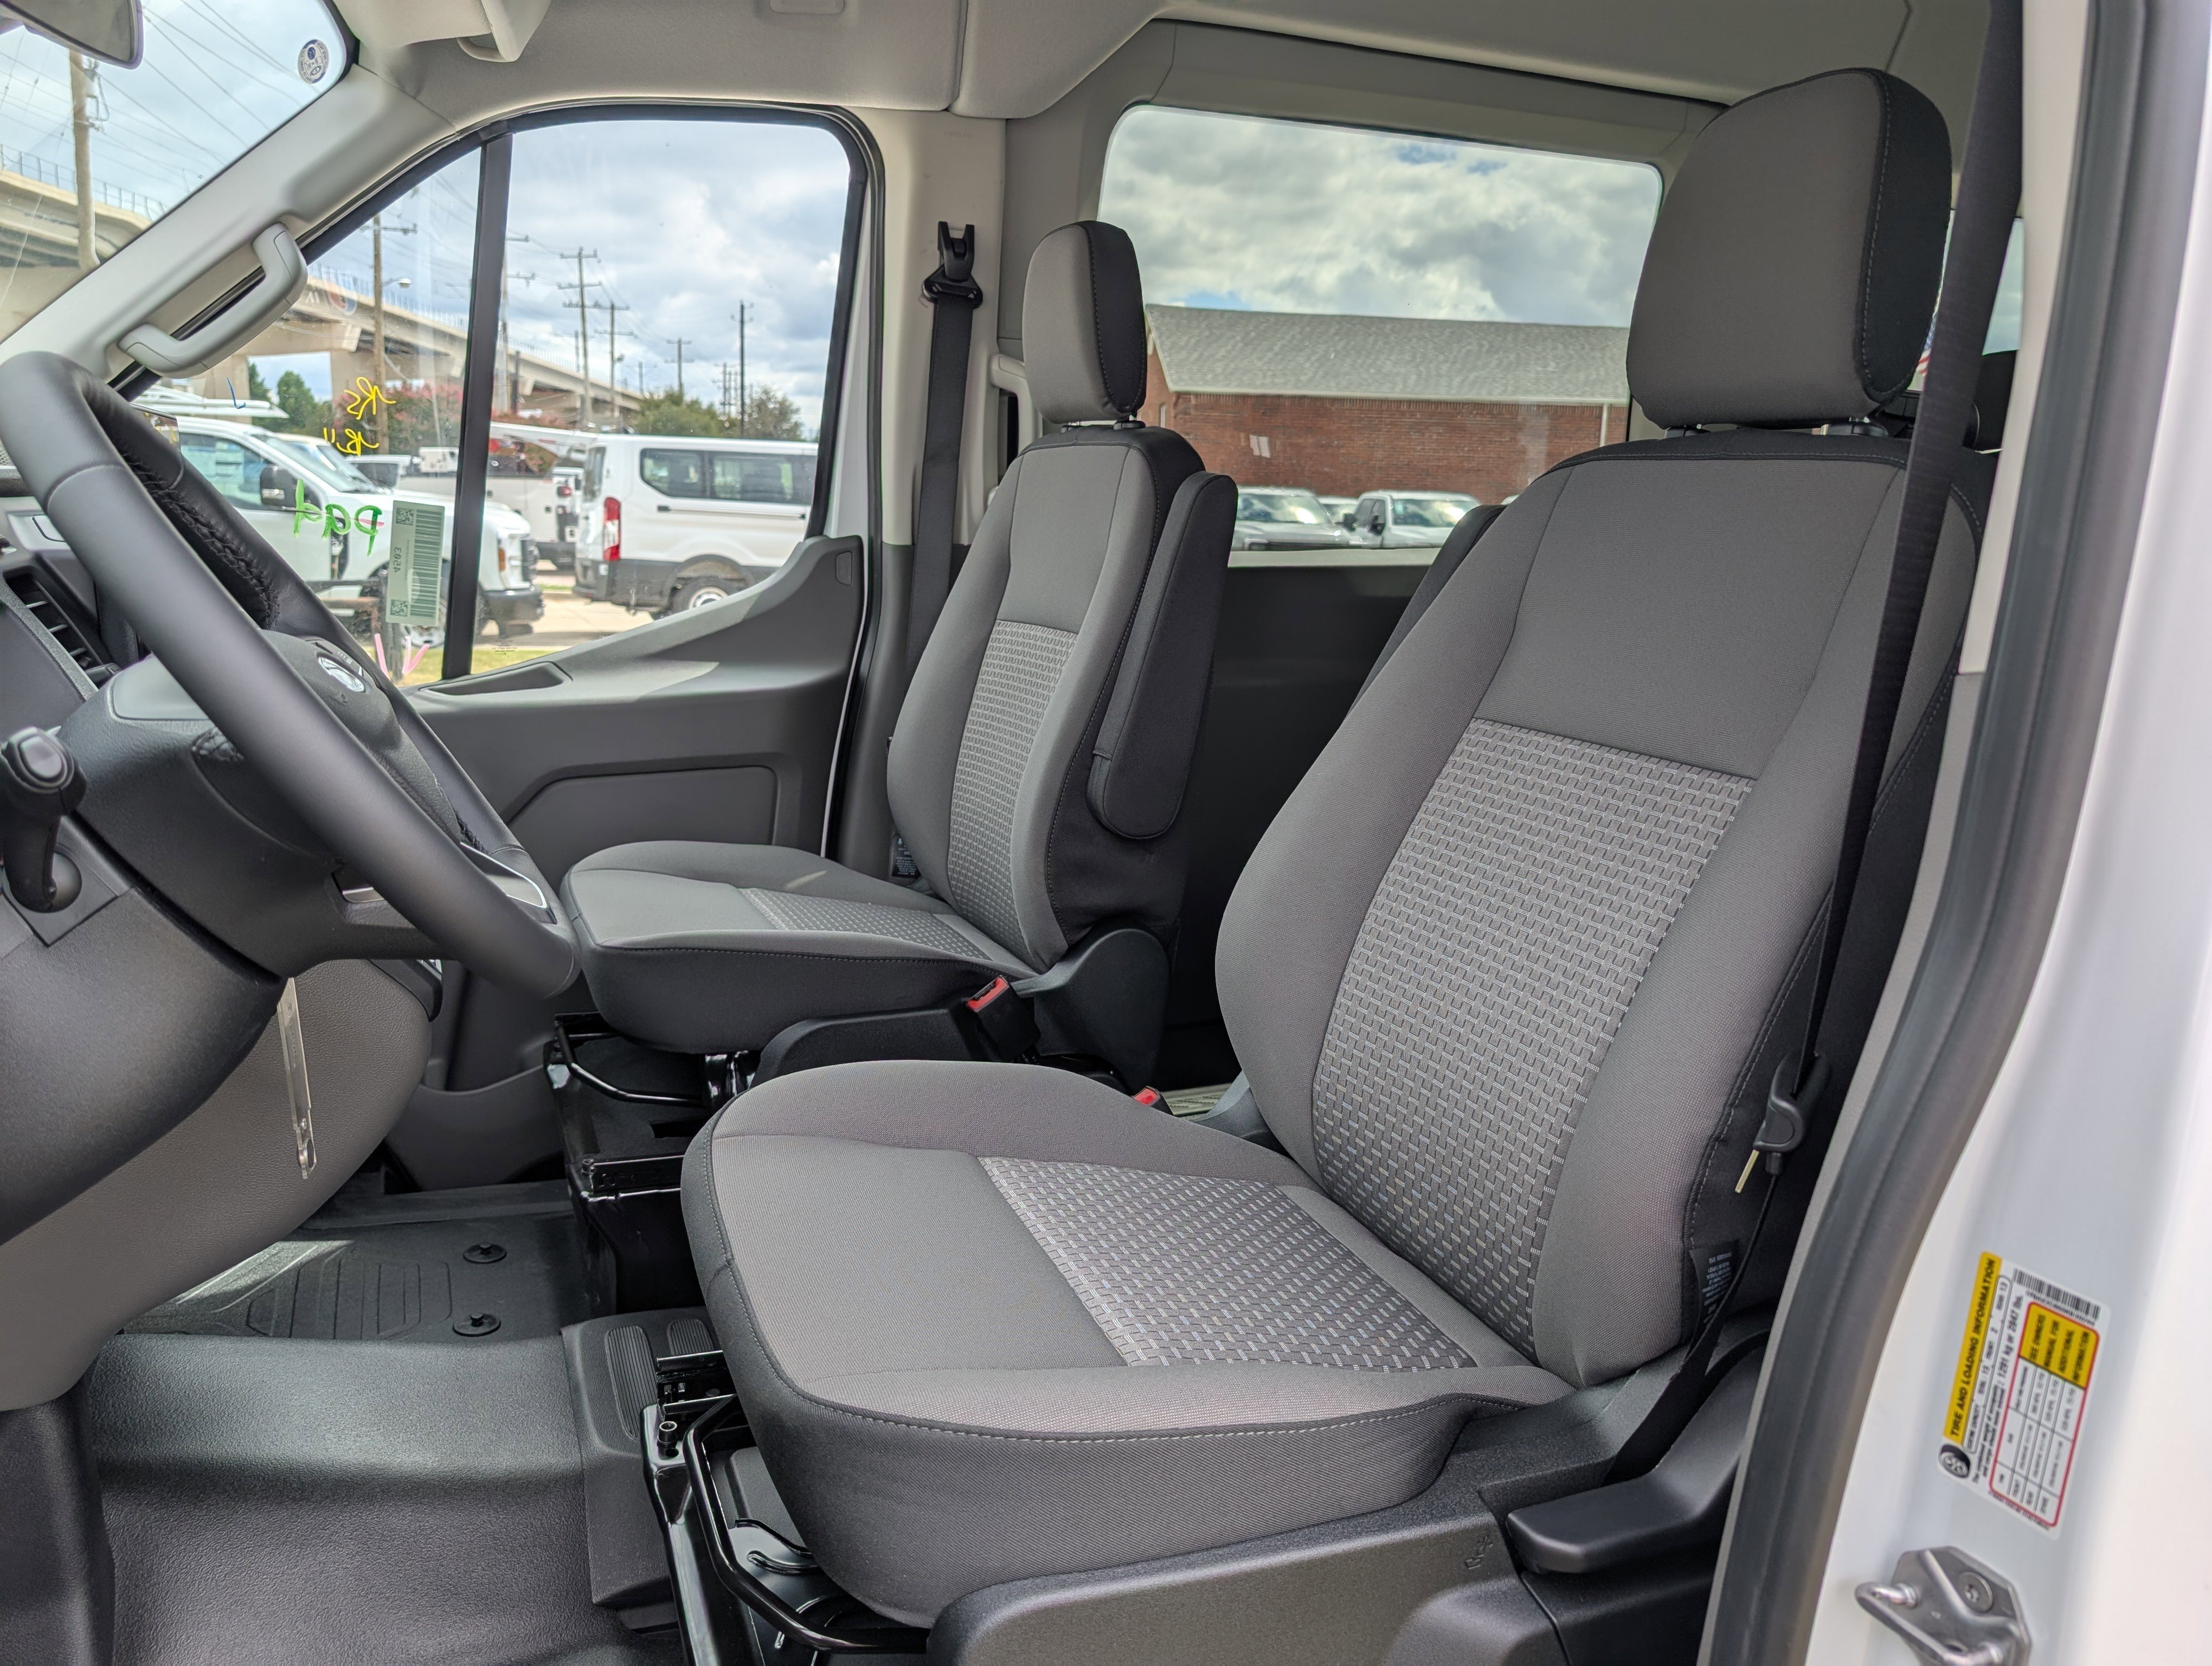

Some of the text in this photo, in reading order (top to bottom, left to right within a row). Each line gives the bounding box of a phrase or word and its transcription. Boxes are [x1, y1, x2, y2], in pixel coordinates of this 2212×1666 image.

[1950, 1259, 1995, 1436] TIRE AND LOADING INFORMATION
